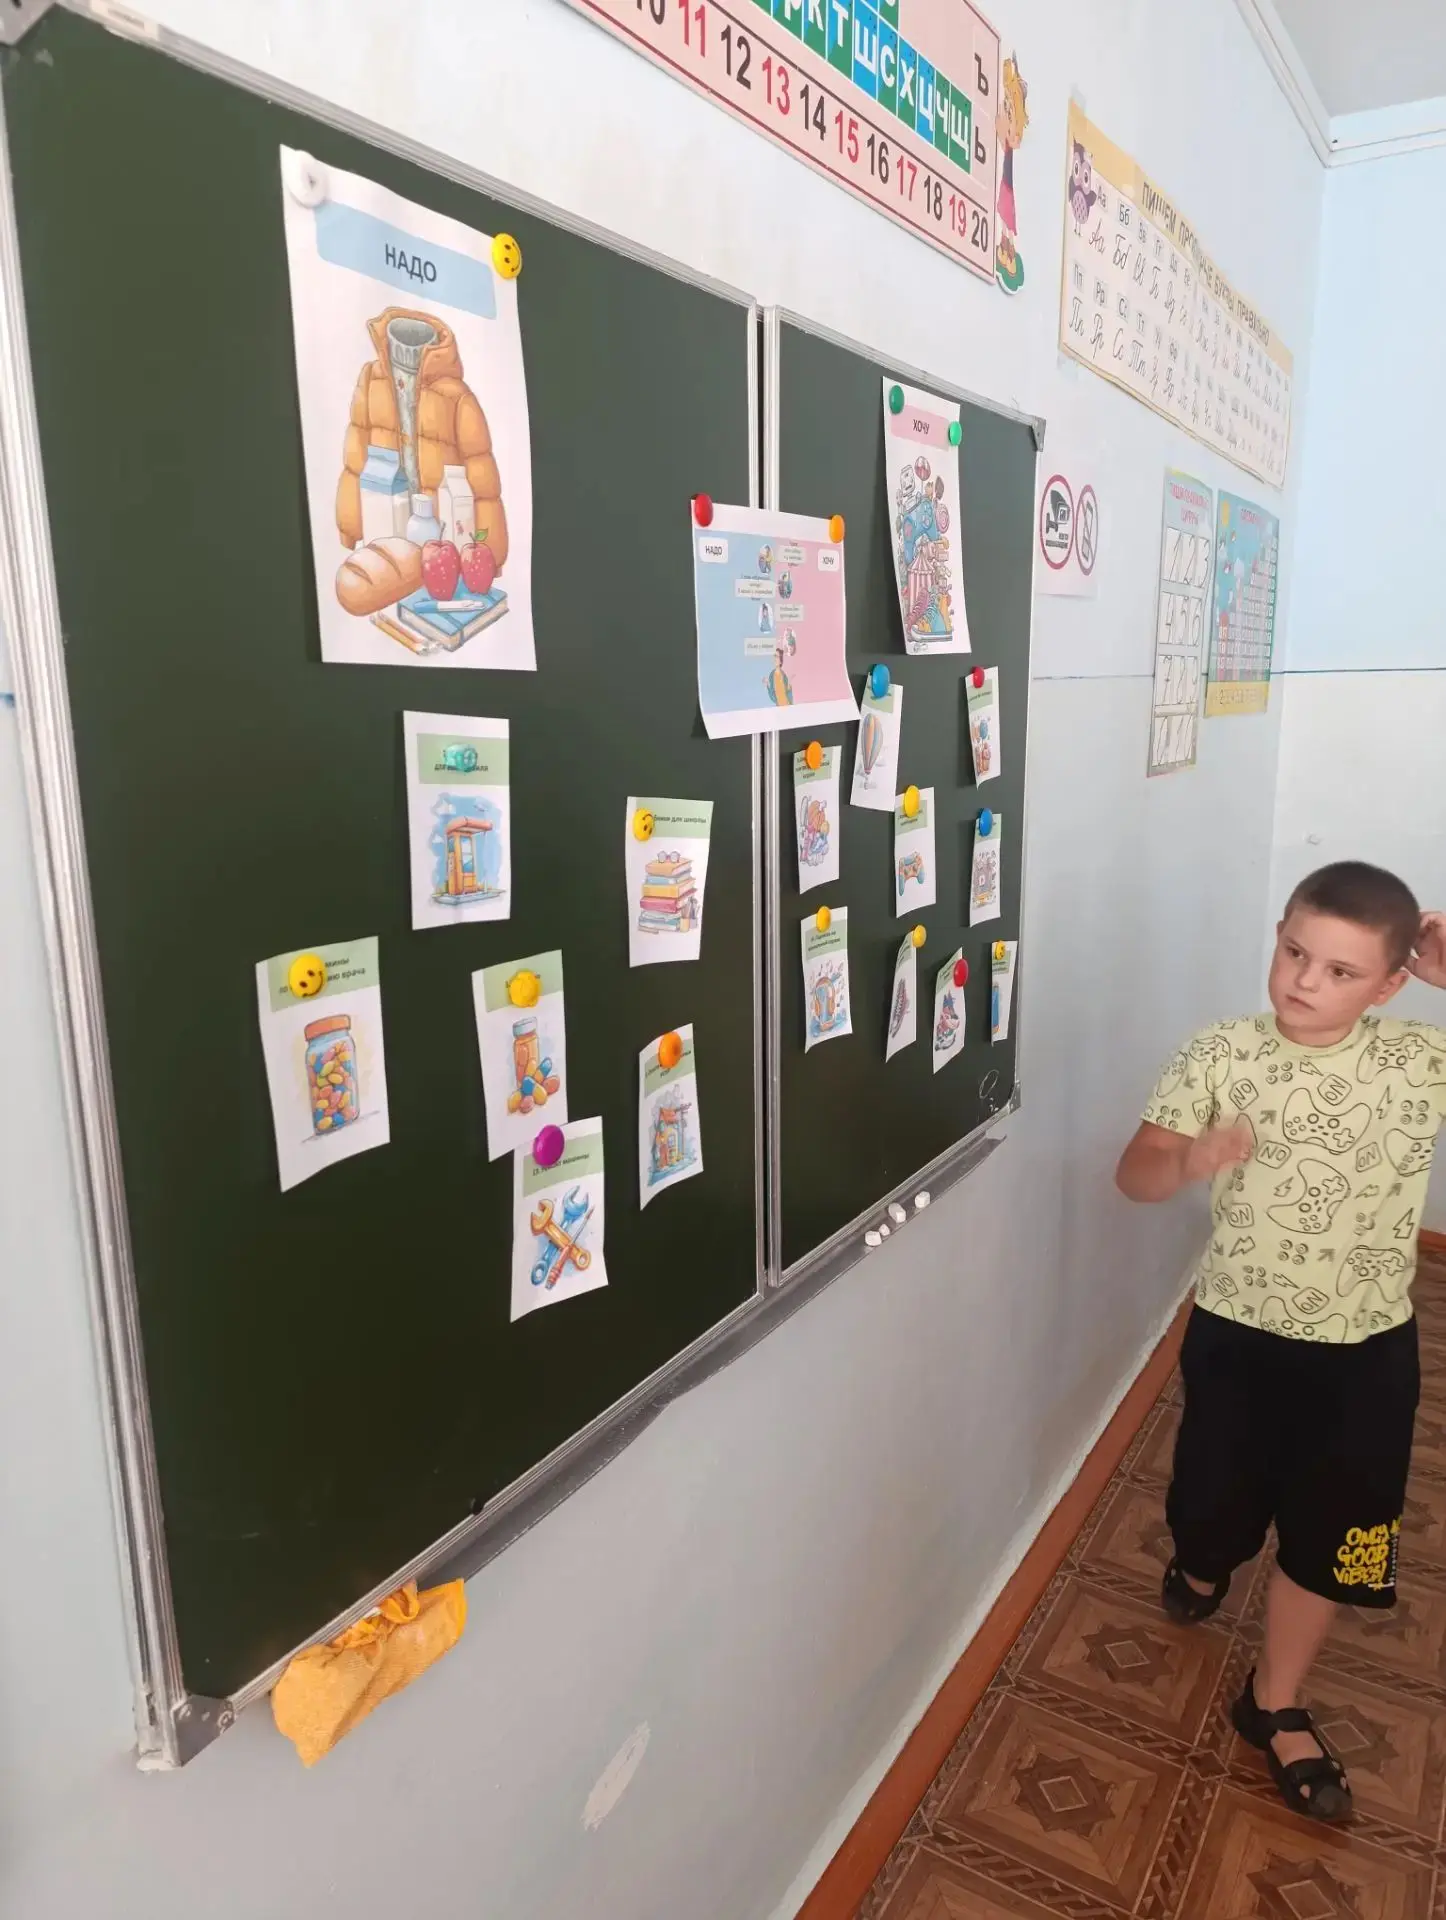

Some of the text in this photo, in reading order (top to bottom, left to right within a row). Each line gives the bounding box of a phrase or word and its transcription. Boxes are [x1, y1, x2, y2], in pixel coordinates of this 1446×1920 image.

[832, 0, 848, 47] Т
[855, 18, 877, 75] Ш
[880, 44, 895, 88] С
[900, 58, 915, 107] Х
[919, 75, 934, 132] Ц
[936, 89, 949, 135] Ч
[951, 103, 969, 161] Щ
[974, 52, 989, 96] Ъ
[678, 0, 705, 58] 11
[720, 24, 752, 90] 12
[762, 55, 791, 115] 13
[800, 83, 827, 141] 14
[834, 109, 860, 163] 15
[866, 133, 890, 184] 16
[896, 154, 918, 201] 17
[923, 175, 943, 221] 18
[949, 194, 967, 237] 19
[971, 209, 989, 252] 20
[974, 126, 987, 165] Ь
[1120, 204, 1130, 226] Бб
[385, 243, 437, 283] НАДО
[705, 544, 723, 556] НАДО
[1230, 1207, 1249, 1225] ON
